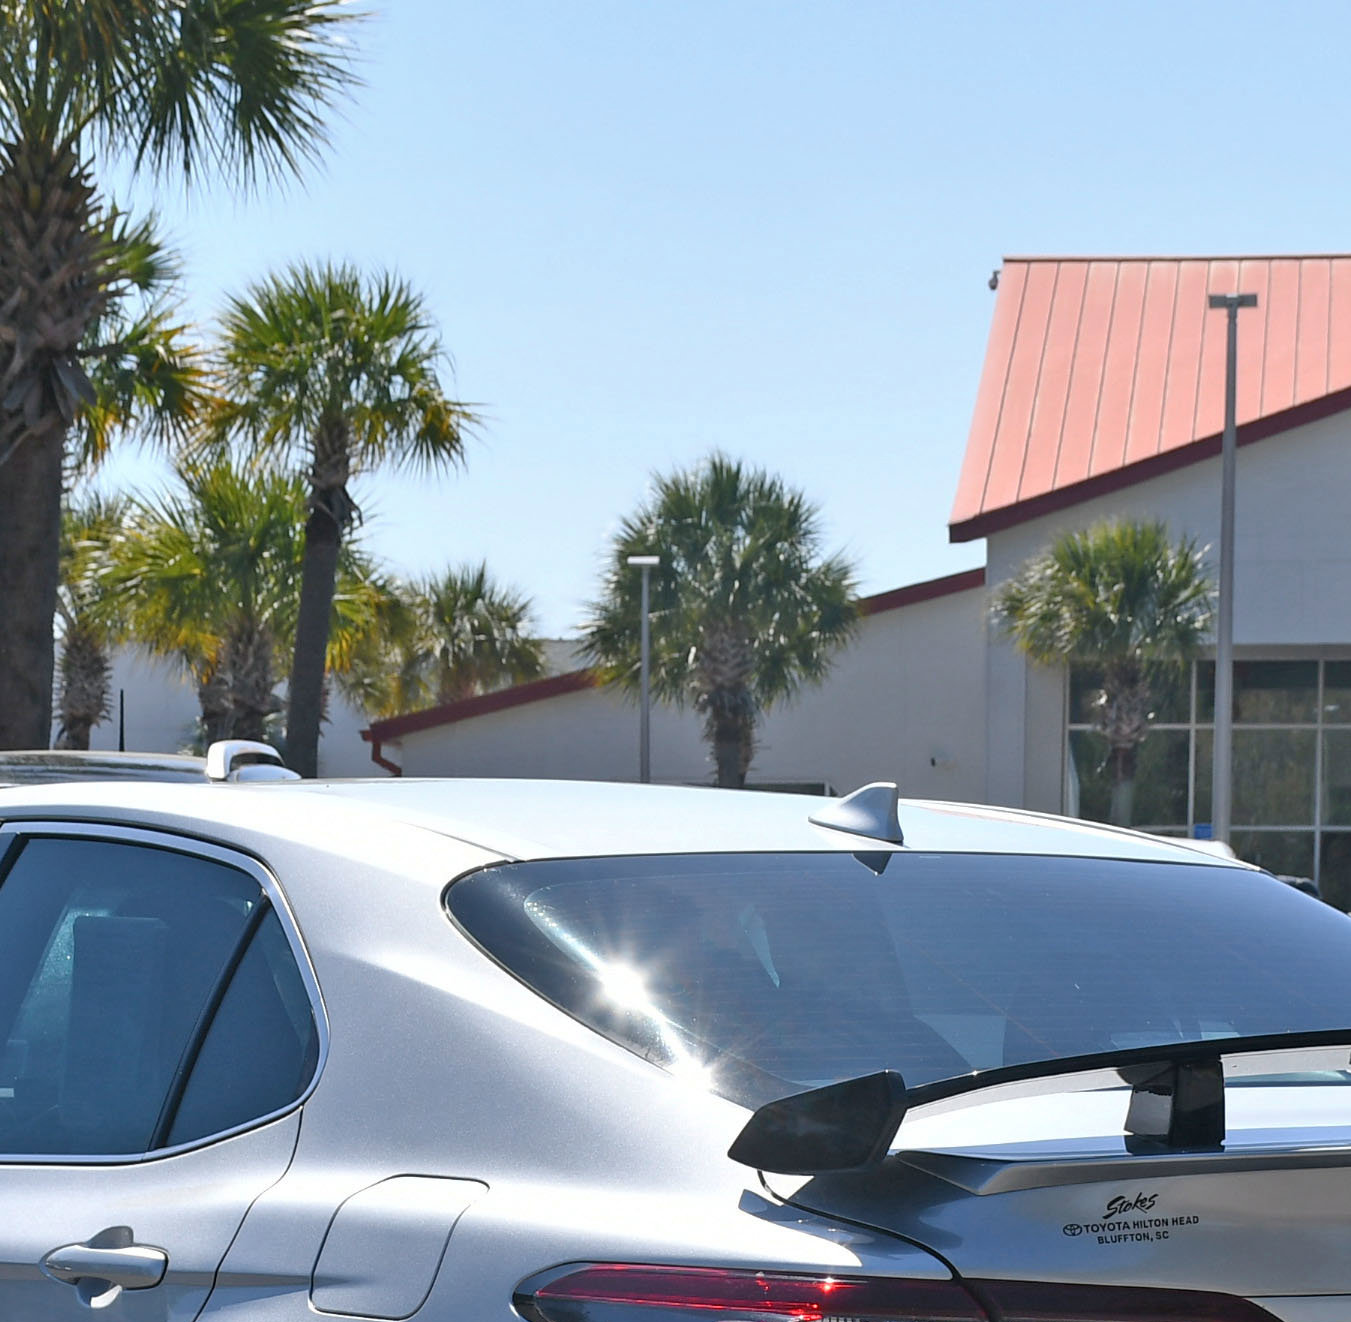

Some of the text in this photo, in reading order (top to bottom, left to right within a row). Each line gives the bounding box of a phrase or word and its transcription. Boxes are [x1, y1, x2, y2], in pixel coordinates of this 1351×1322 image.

[1102, 1191, 1159, 1219] Stokes
[1083, 1215, 1200, 1234] TOYOTA HILTON HEAD
[1097, 1230, 1169, 1245] BLUFFTON, SC
